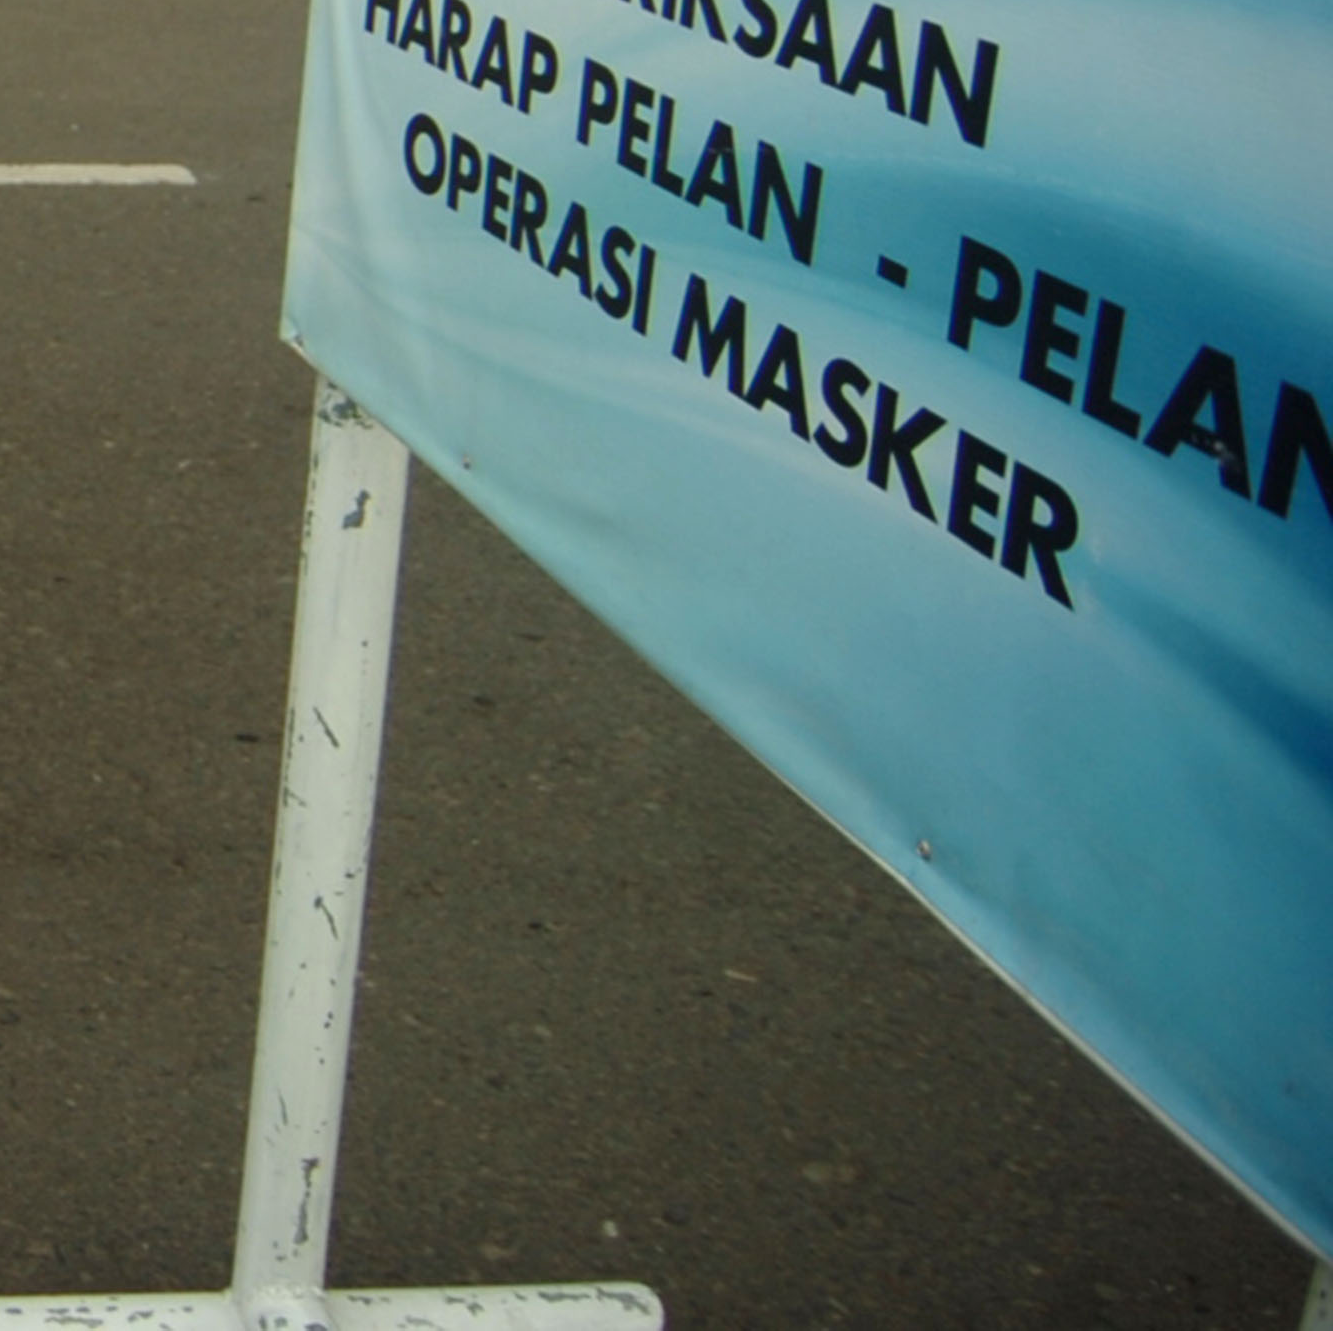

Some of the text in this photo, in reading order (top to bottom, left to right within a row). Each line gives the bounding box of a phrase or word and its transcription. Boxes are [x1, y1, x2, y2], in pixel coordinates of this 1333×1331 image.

[404, 113, 1080, 612] OPERASI MASKER
[576, 58, 823, 267] PELAN
[947, 234, 1333, 525] PELAN
